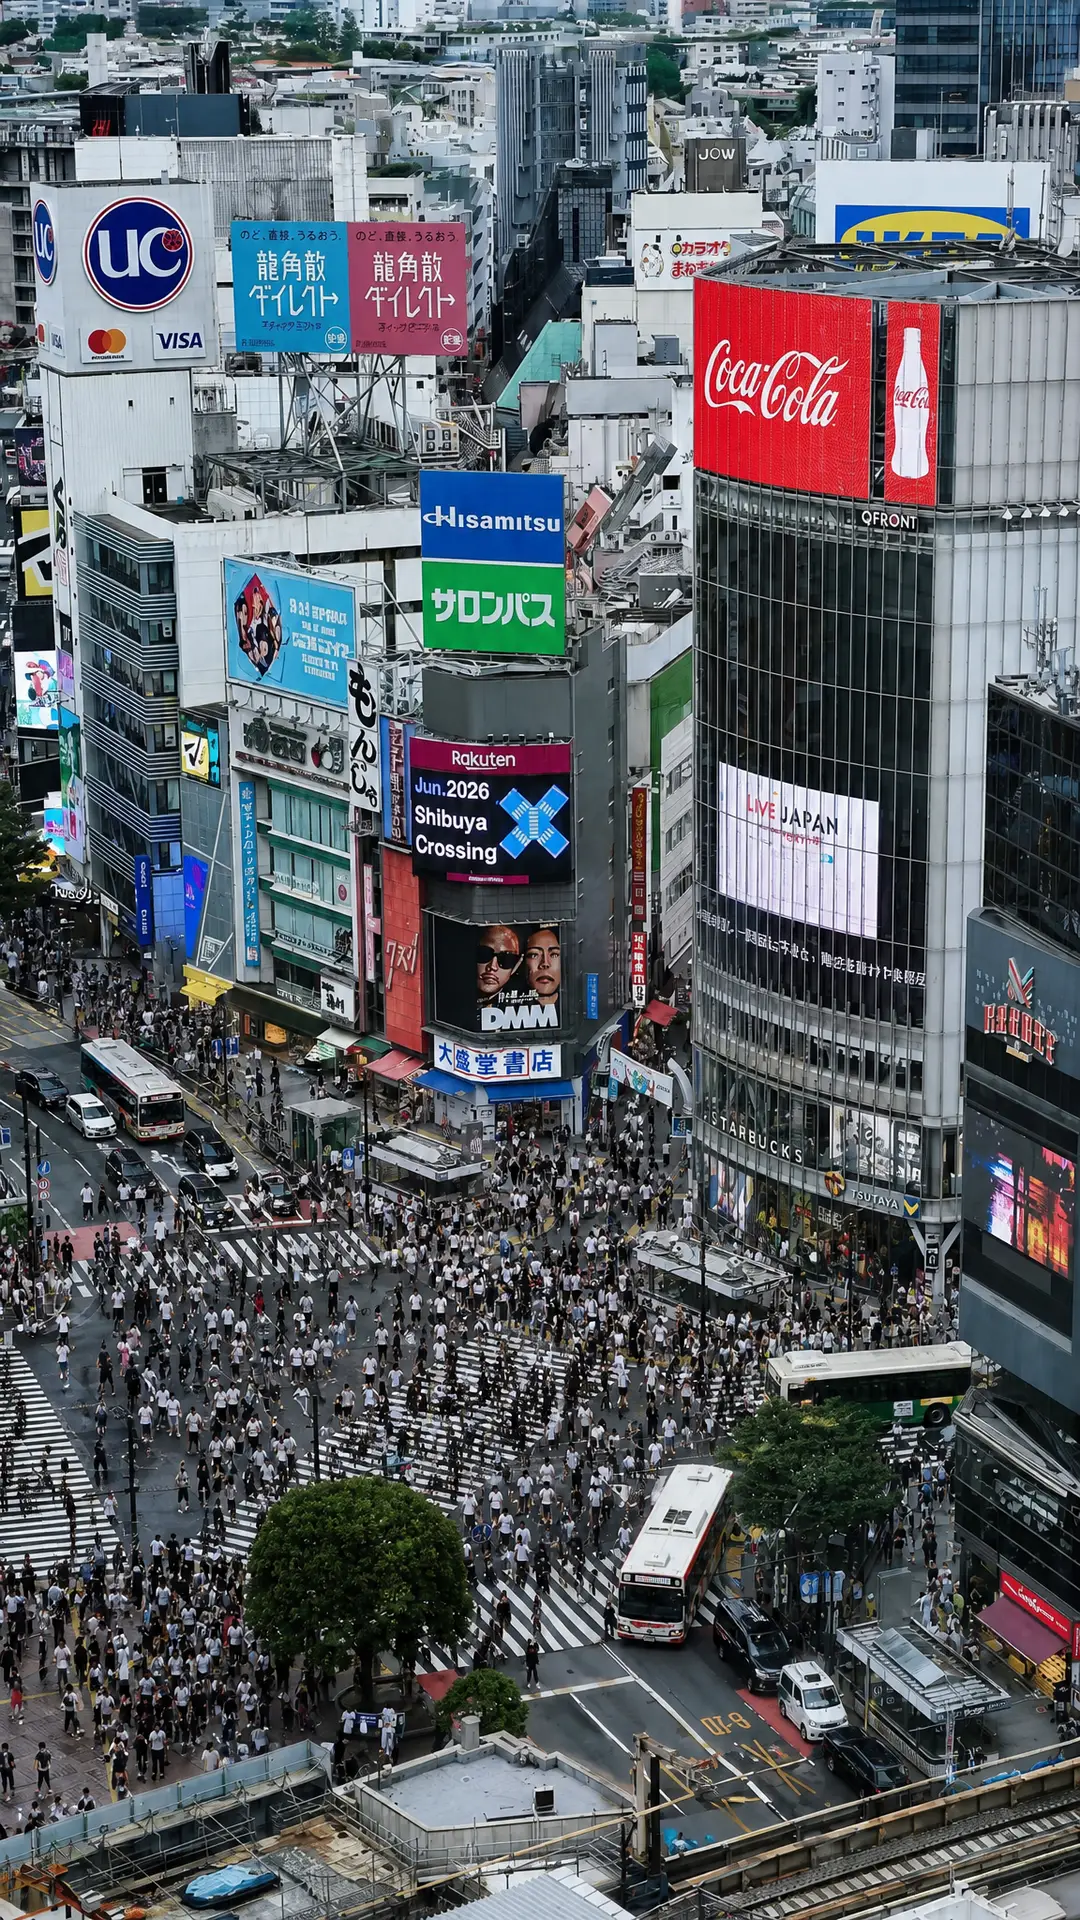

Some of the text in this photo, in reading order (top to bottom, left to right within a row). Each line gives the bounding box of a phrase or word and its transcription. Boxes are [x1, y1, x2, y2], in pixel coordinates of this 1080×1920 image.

[698, 147, 736, 160] JOW
[34, 221, 54, 262] UC
[97, 226, 182, 279] UC
[256, 249, 326, 282] 龍角散
[372, 251, 443, 283] 龍角散
[155, 332, 203, 350] VISA
[704, 339, 850, 428] Coca-Cola
[422, 505, 561, 533] Hisamitsu
[861, 510, 918, 530] QFRONT
[431, 587, 556, 628] サロンパス
[451, 750, 516, 768] Rakuten
[414, 804, 488, 835] Shibuya
[747, 793, 776, 820] LIVE
[780, 806, 839, 836] JAPAN
[415, 834, 498, 865] Crossing
[481, 1003, 559, 1031] DMM
[438, 1041, 554, 1076] 大盛堂書店
[710, 1114, 803, 1164] STARBUCKS
[851, 1189, 899, 1211] TSUTAYA
